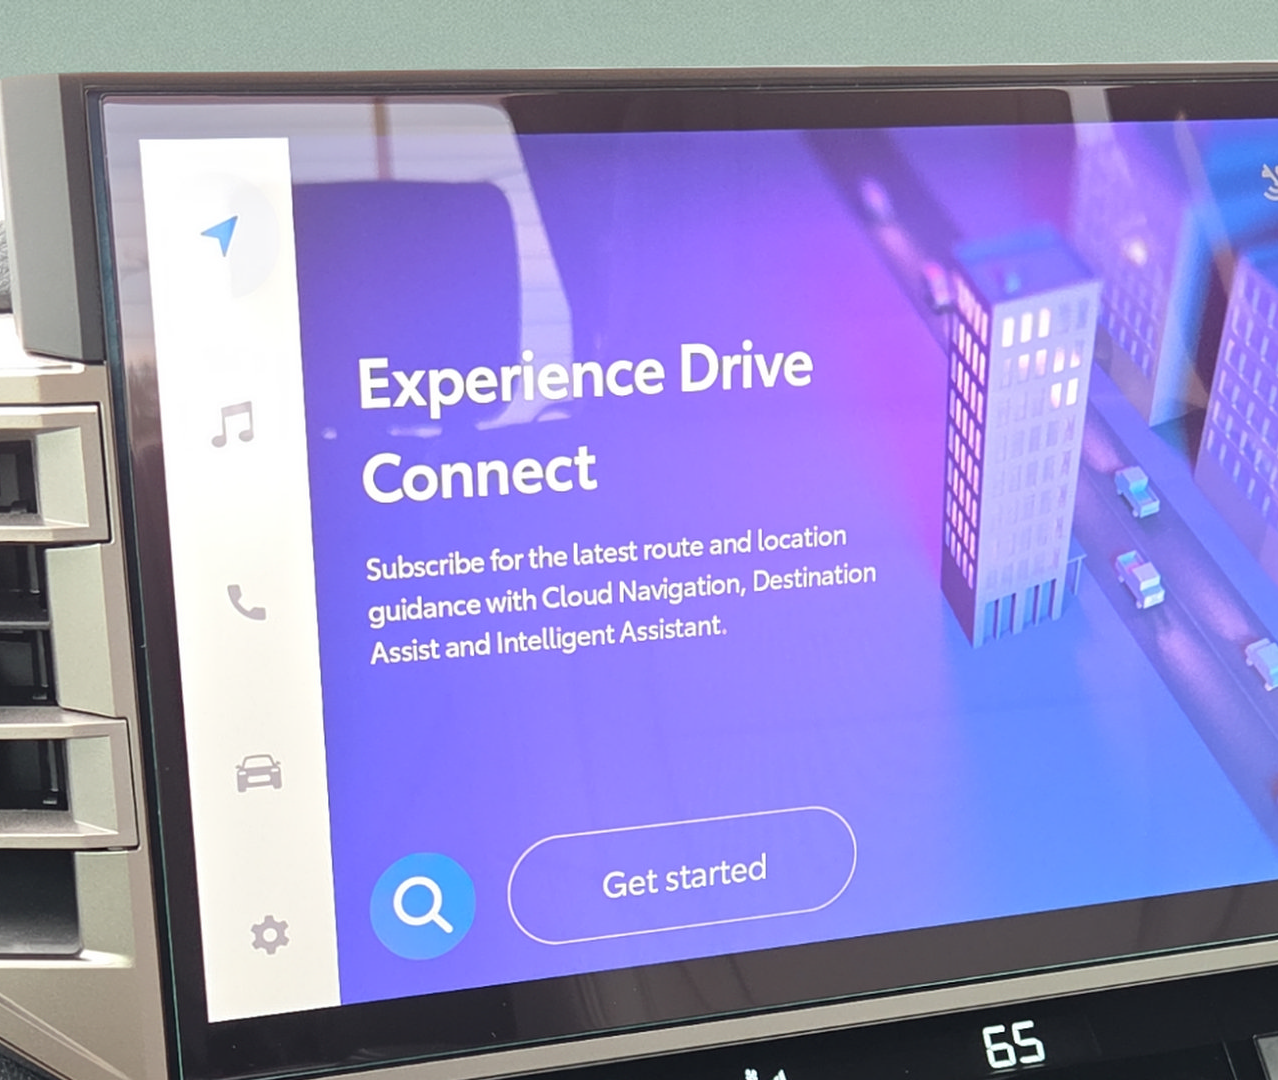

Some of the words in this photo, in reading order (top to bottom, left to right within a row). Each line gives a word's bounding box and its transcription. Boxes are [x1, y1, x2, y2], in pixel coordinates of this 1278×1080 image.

[359, 347, 665, 420] Experience
[681, 340, 813, 392] Drive
[363, 446, 597, 503] Connect
[367, 551, 484, 581] Subscribe
[490, 549, 524, 571] for
[528, 546, 567, 568] the
[574, 541, 638, 565] latest
[644, 538, 703, 560] route
[710, 530, 751, 554] and
[758, 526, 846, 551] location
[369, 596, 481, 628] guidance
[486, 588, 536, 613] with
[542, 581, 612, 608] Cloud
[620, 575, 746, 604] Navigation,
[754, 563, 876, 591] Destination
[371, 639, 440, 664] Assist
[446, 632, 490, 658] and
[497, 625, 615, 654] Intelligent
[620, 615, 726, 643] Assistant.
[603, 870, 658, 898] Get
[666, 853, 766, 891] started
[983, 1021, 1045, 1068] 65
